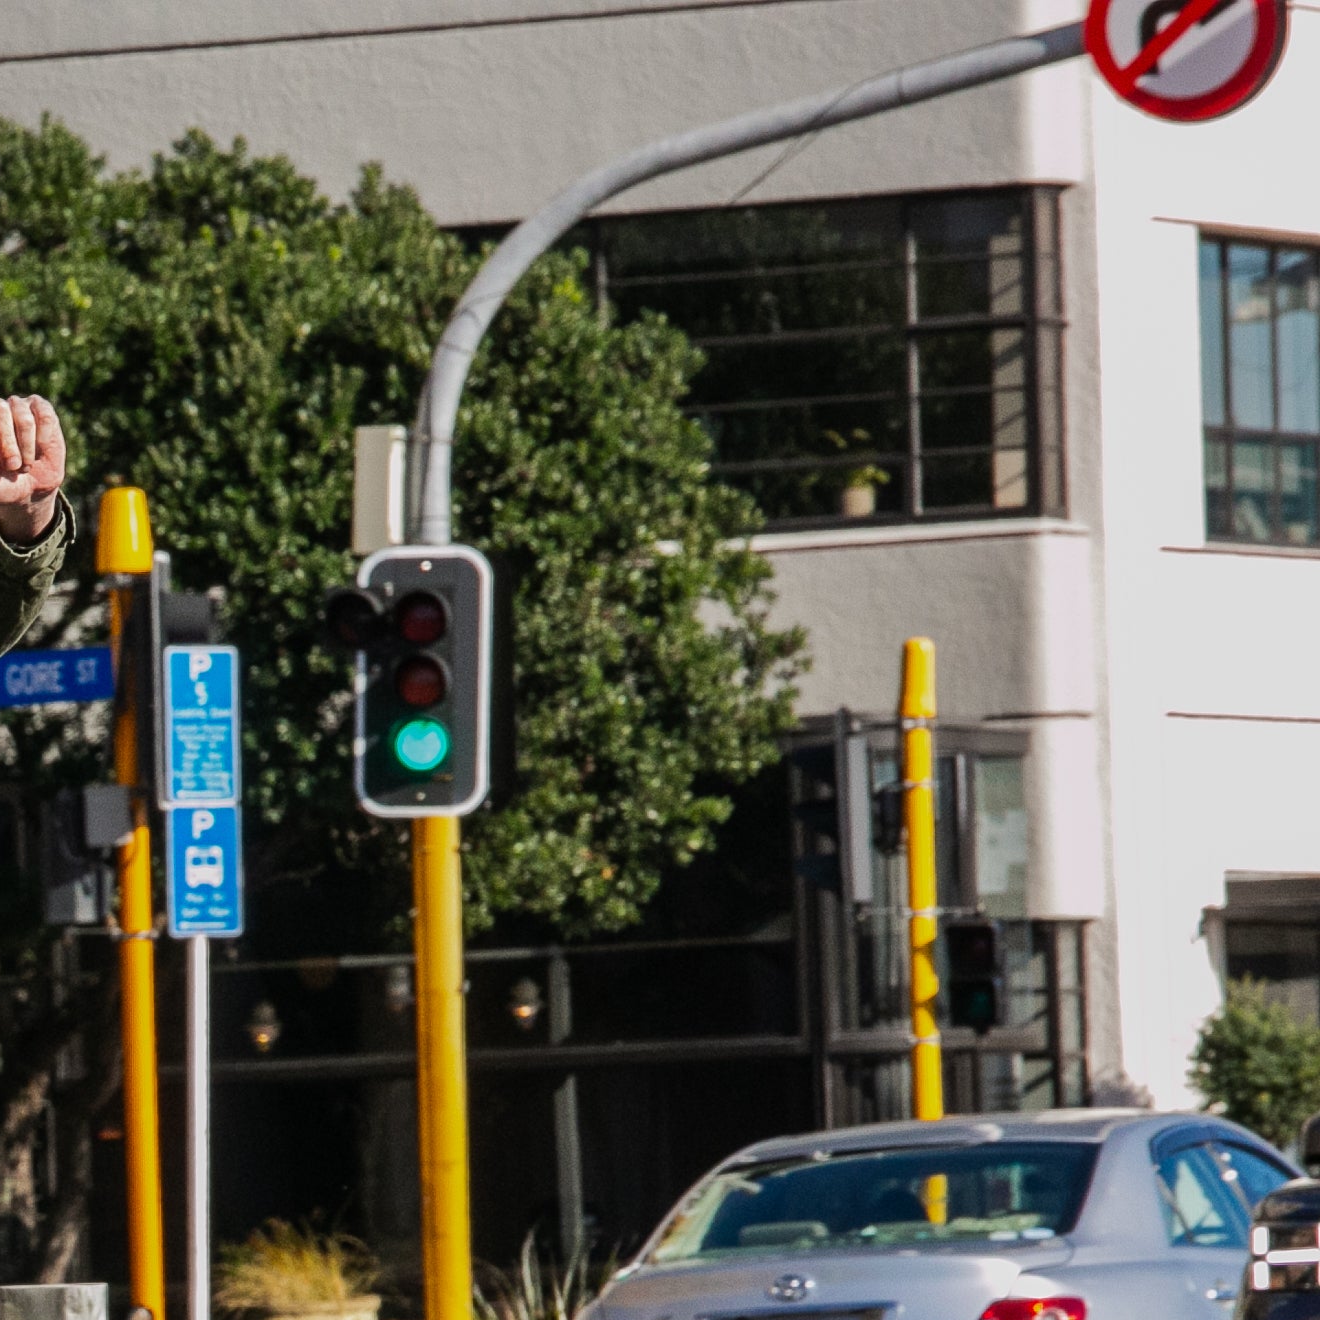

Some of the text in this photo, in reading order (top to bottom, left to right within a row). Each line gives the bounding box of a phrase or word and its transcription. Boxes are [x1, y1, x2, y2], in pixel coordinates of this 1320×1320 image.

[6, 657, 98, 696] GORE ST
[189, 653, 212, 681] P
[192, 809, 215, 840] P
